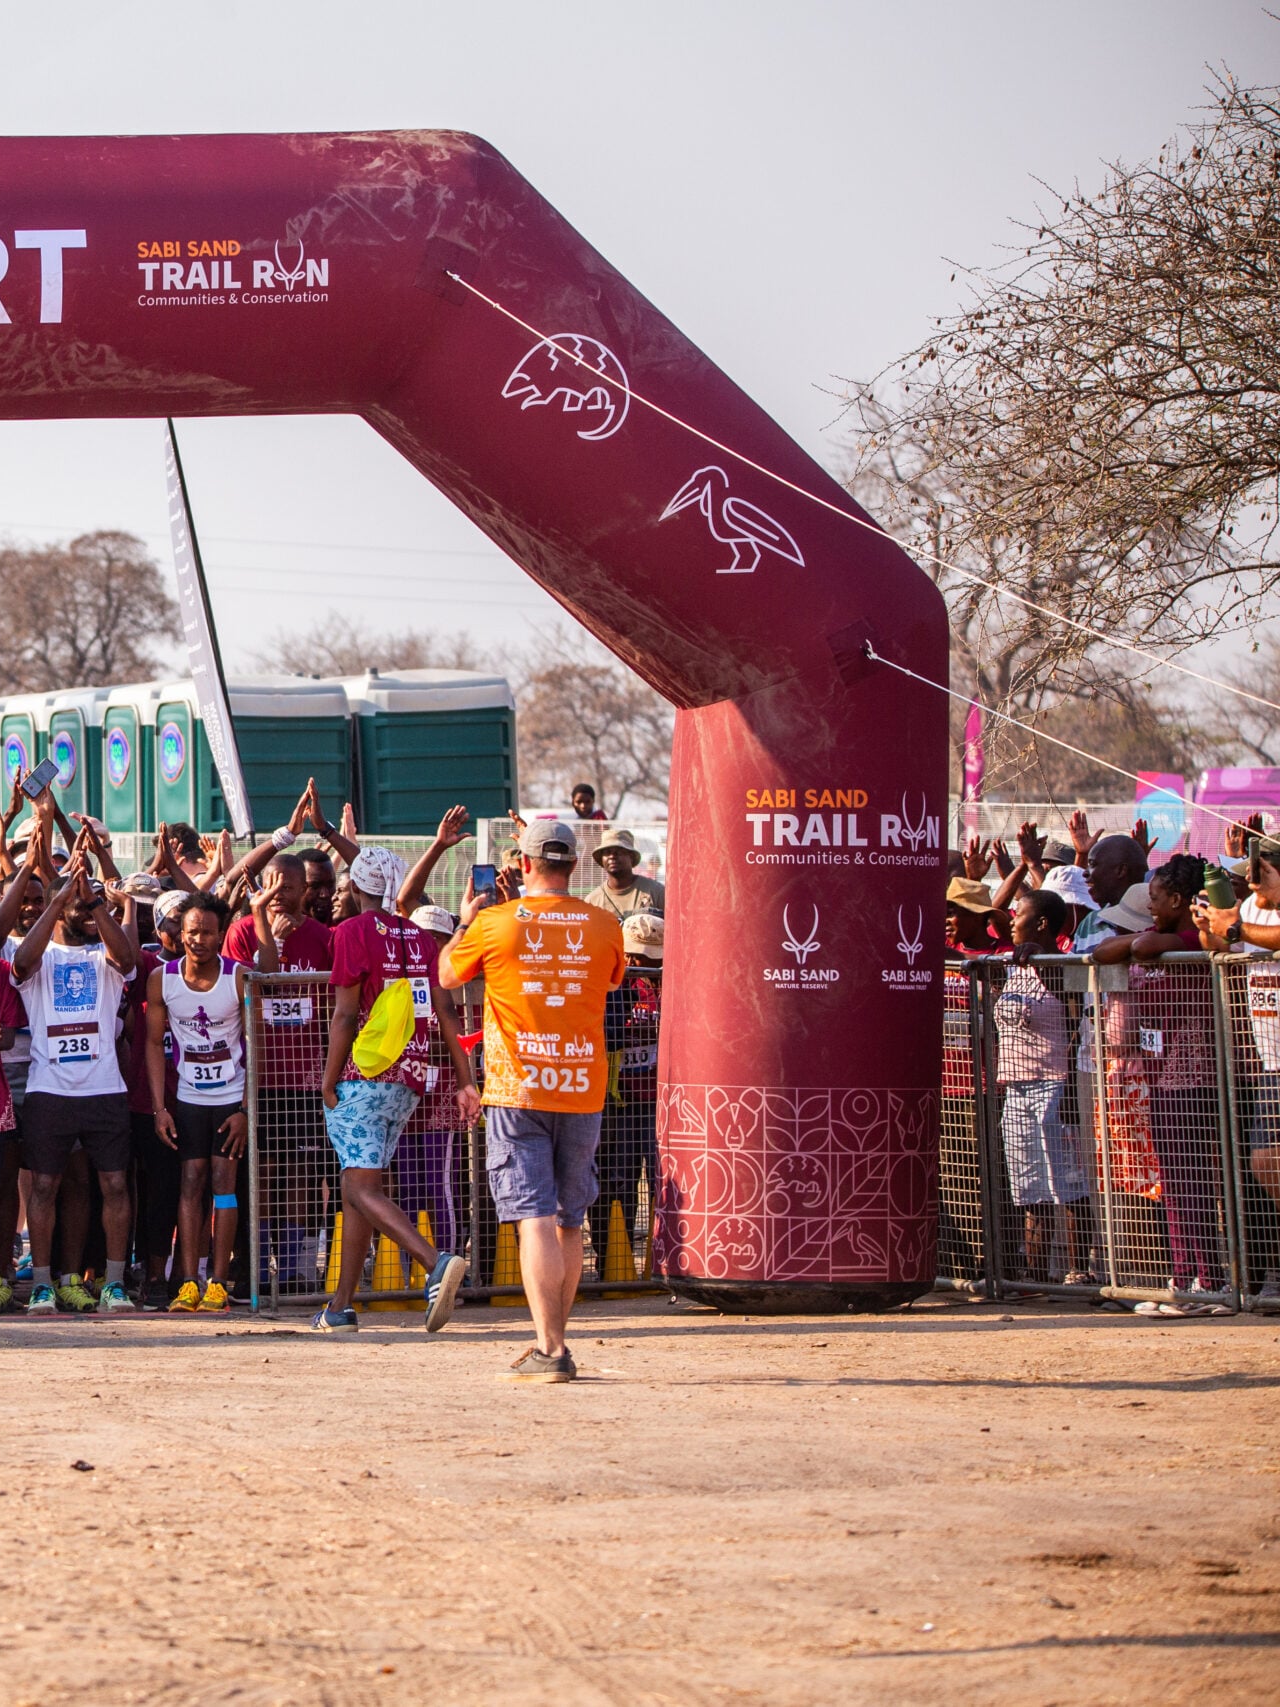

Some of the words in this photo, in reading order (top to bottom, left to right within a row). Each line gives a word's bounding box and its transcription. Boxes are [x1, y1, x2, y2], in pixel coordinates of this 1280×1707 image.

[137, 241, 181, 259] SABI
[188, 240, 241, 257] SAND
[138, 261, 241, 290] TRAIL
[138, 294, 225, 307] Communities
[229, 294, 238, 305] &
[242, 291, 329, 305] Conservation
[745, 789, 796, 808] SABI
[805, 789, 868, 808] SAND
[745, 813, 868, 847] TRAIL
[745, 851, 850, 865] Communities
[854, 852, 865, 865] &
[869, 851, 940, 867] Conservation
[538, 912, 589, 920] AIRLINK
[763, 968, 795, 981] SABI
[800, 969, 840, 982] SAND
[881, 970, 906, 982] SABI
[910, 970, 932, 983] SAND
[272, 1002, 301, 1016] 334
[536, 1033, 560, 1041] SAND
[58, 1038, 90, 1054] 238
[517, 1040, 560, 1056] TRAIL
[194, 1066, 223, 1080] 317
[521, 1064, 591, 1093] 2025
